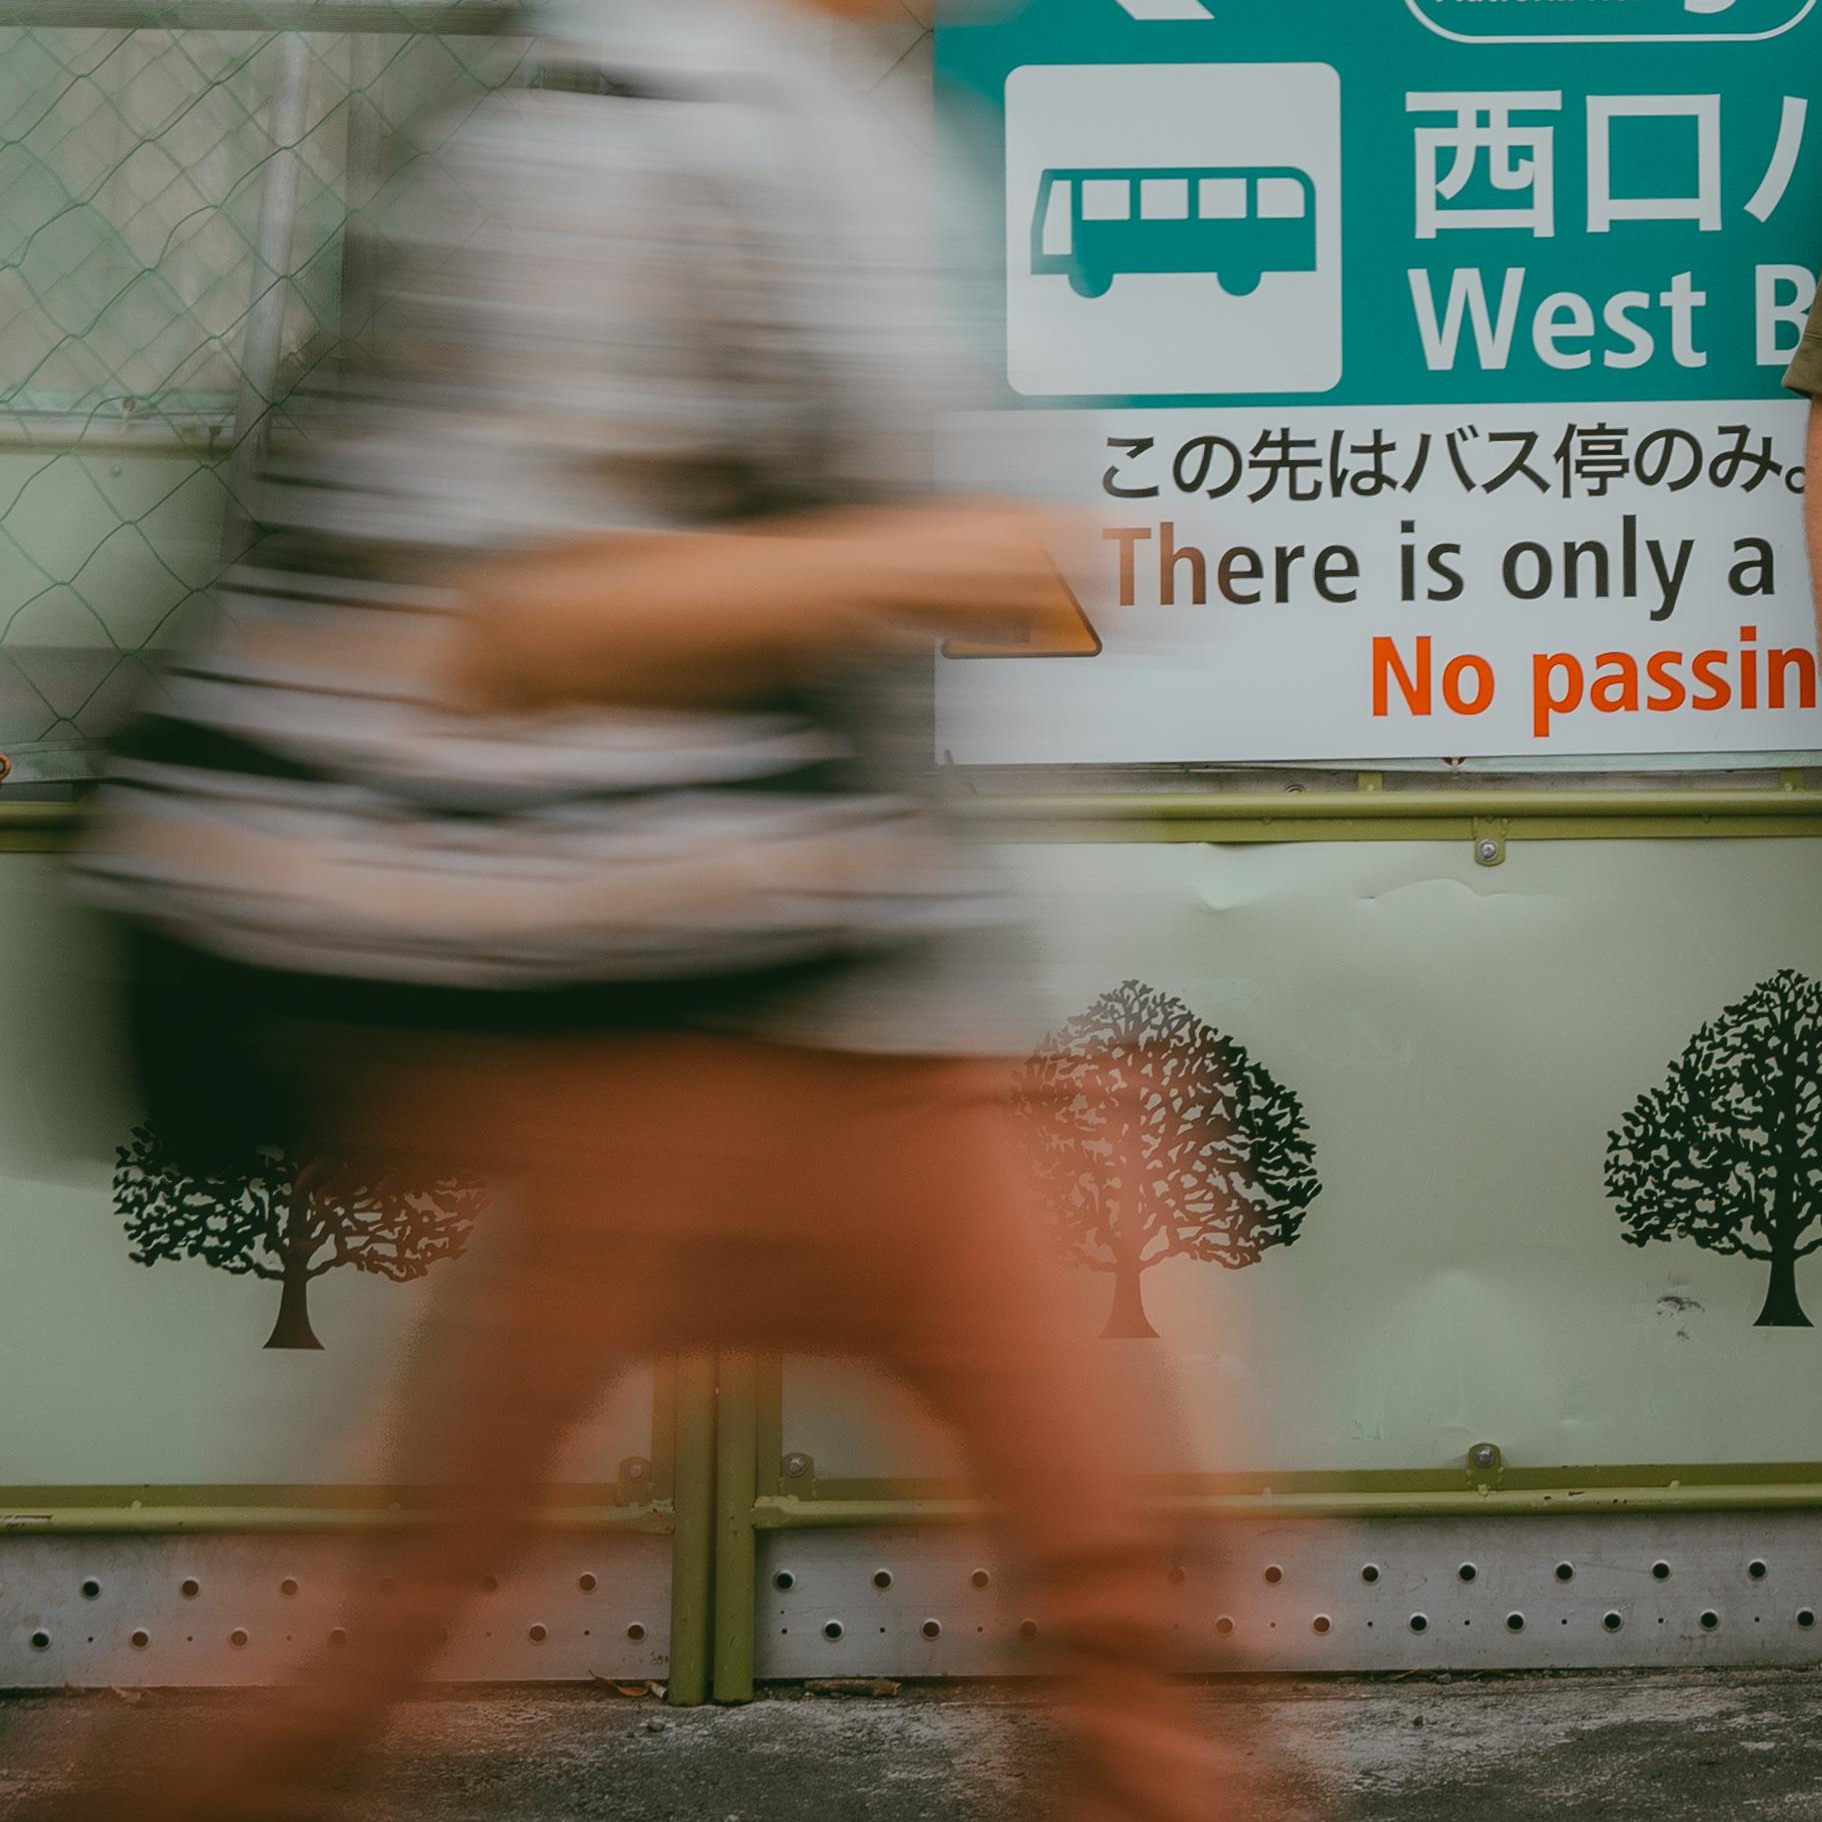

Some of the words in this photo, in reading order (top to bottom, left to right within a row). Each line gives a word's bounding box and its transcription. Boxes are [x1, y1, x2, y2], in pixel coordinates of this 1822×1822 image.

[1407, 266, 1707, 371] West
[1100, 421, 1806, 504] この先はバス停のみ。
[1100, 520, 1360, 607] There
[1399, 519, 1465, 603] is
[1500, 514, 1694, 622] only
[1727, 533, 1775, 596] a
[1372, 635, 1495, 717] No
